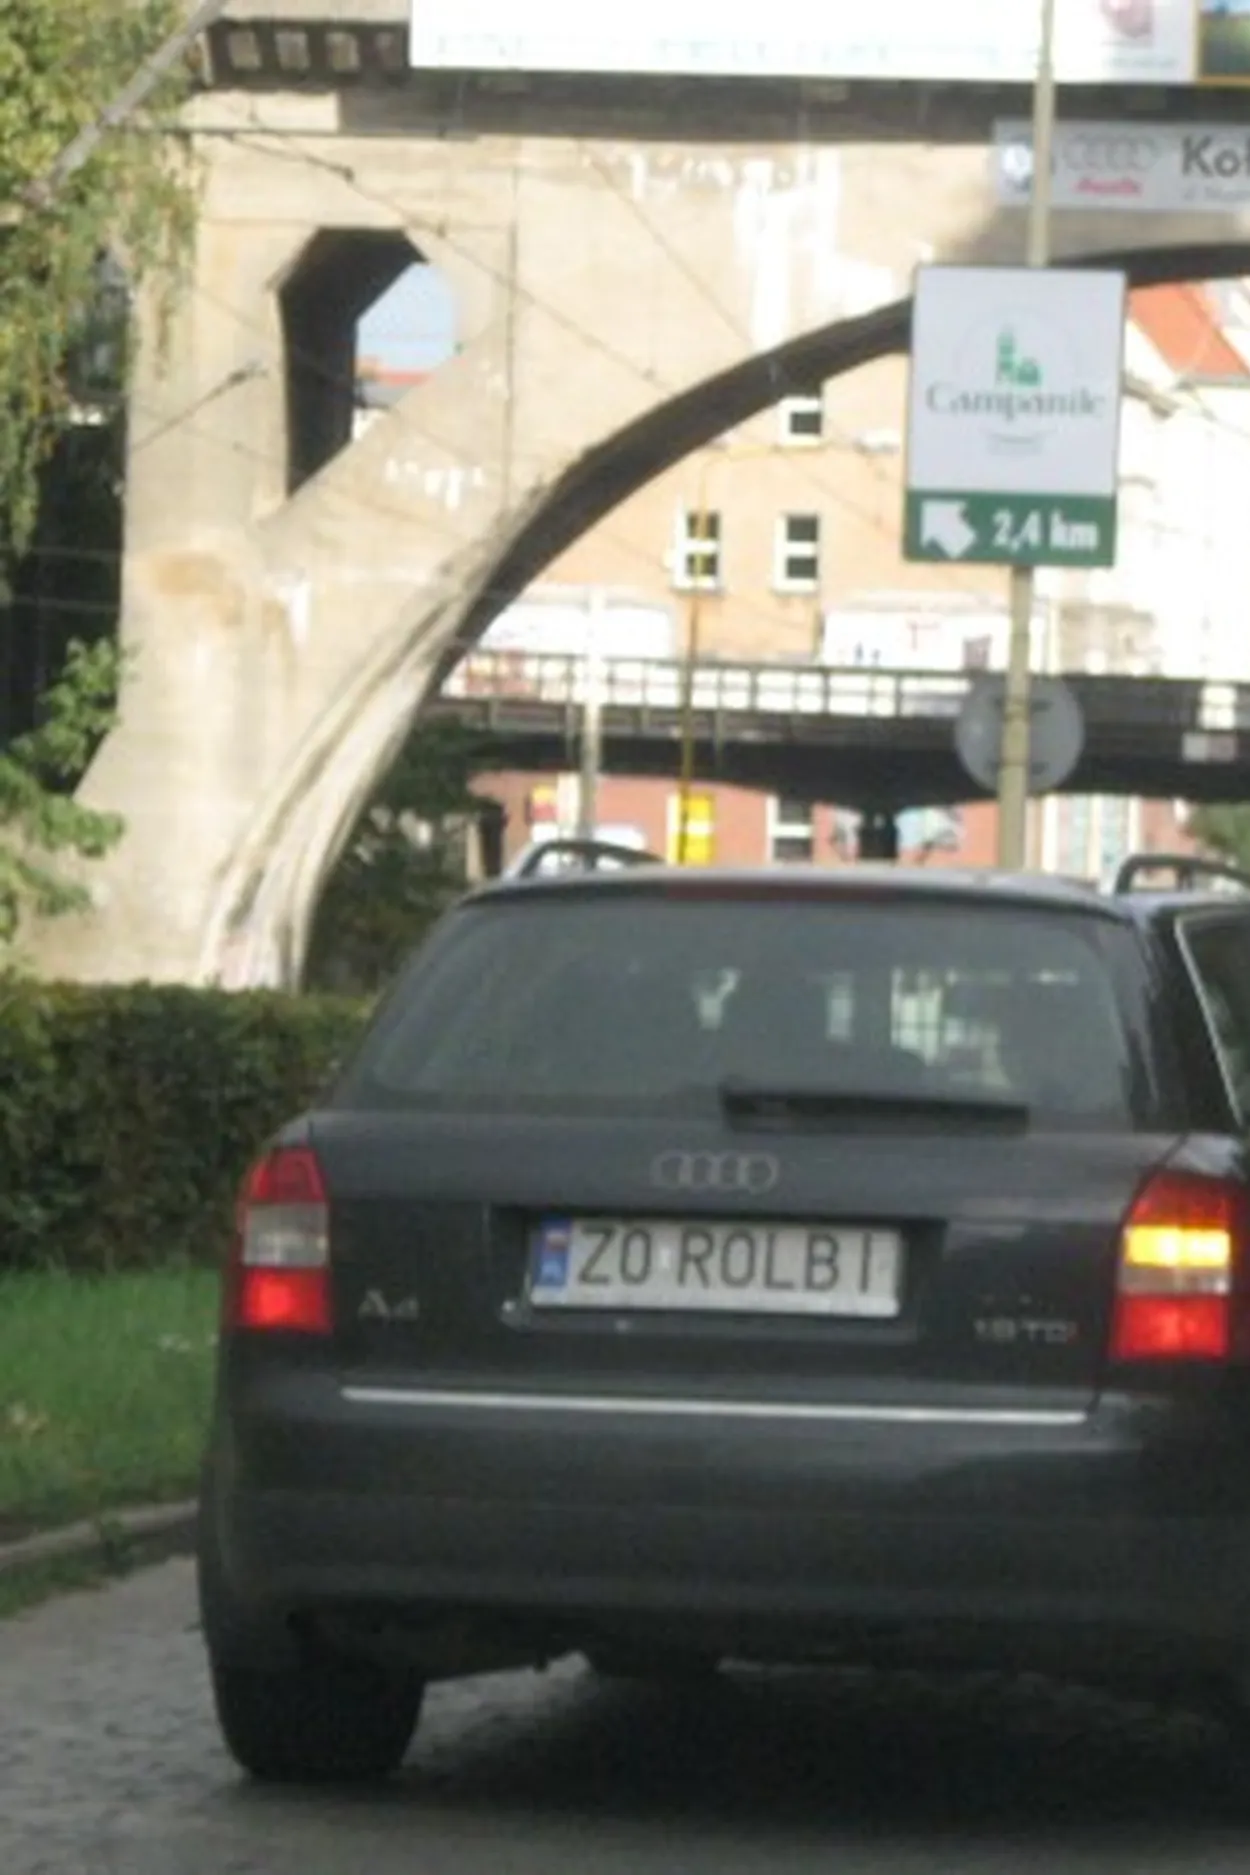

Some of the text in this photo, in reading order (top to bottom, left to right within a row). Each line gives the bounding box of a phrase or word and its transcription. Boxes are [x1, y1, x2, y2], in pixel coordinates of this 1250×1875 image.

[925, 380, 1106, 422] Campanile
[993, 508, 1099, 551] 2,4 km
